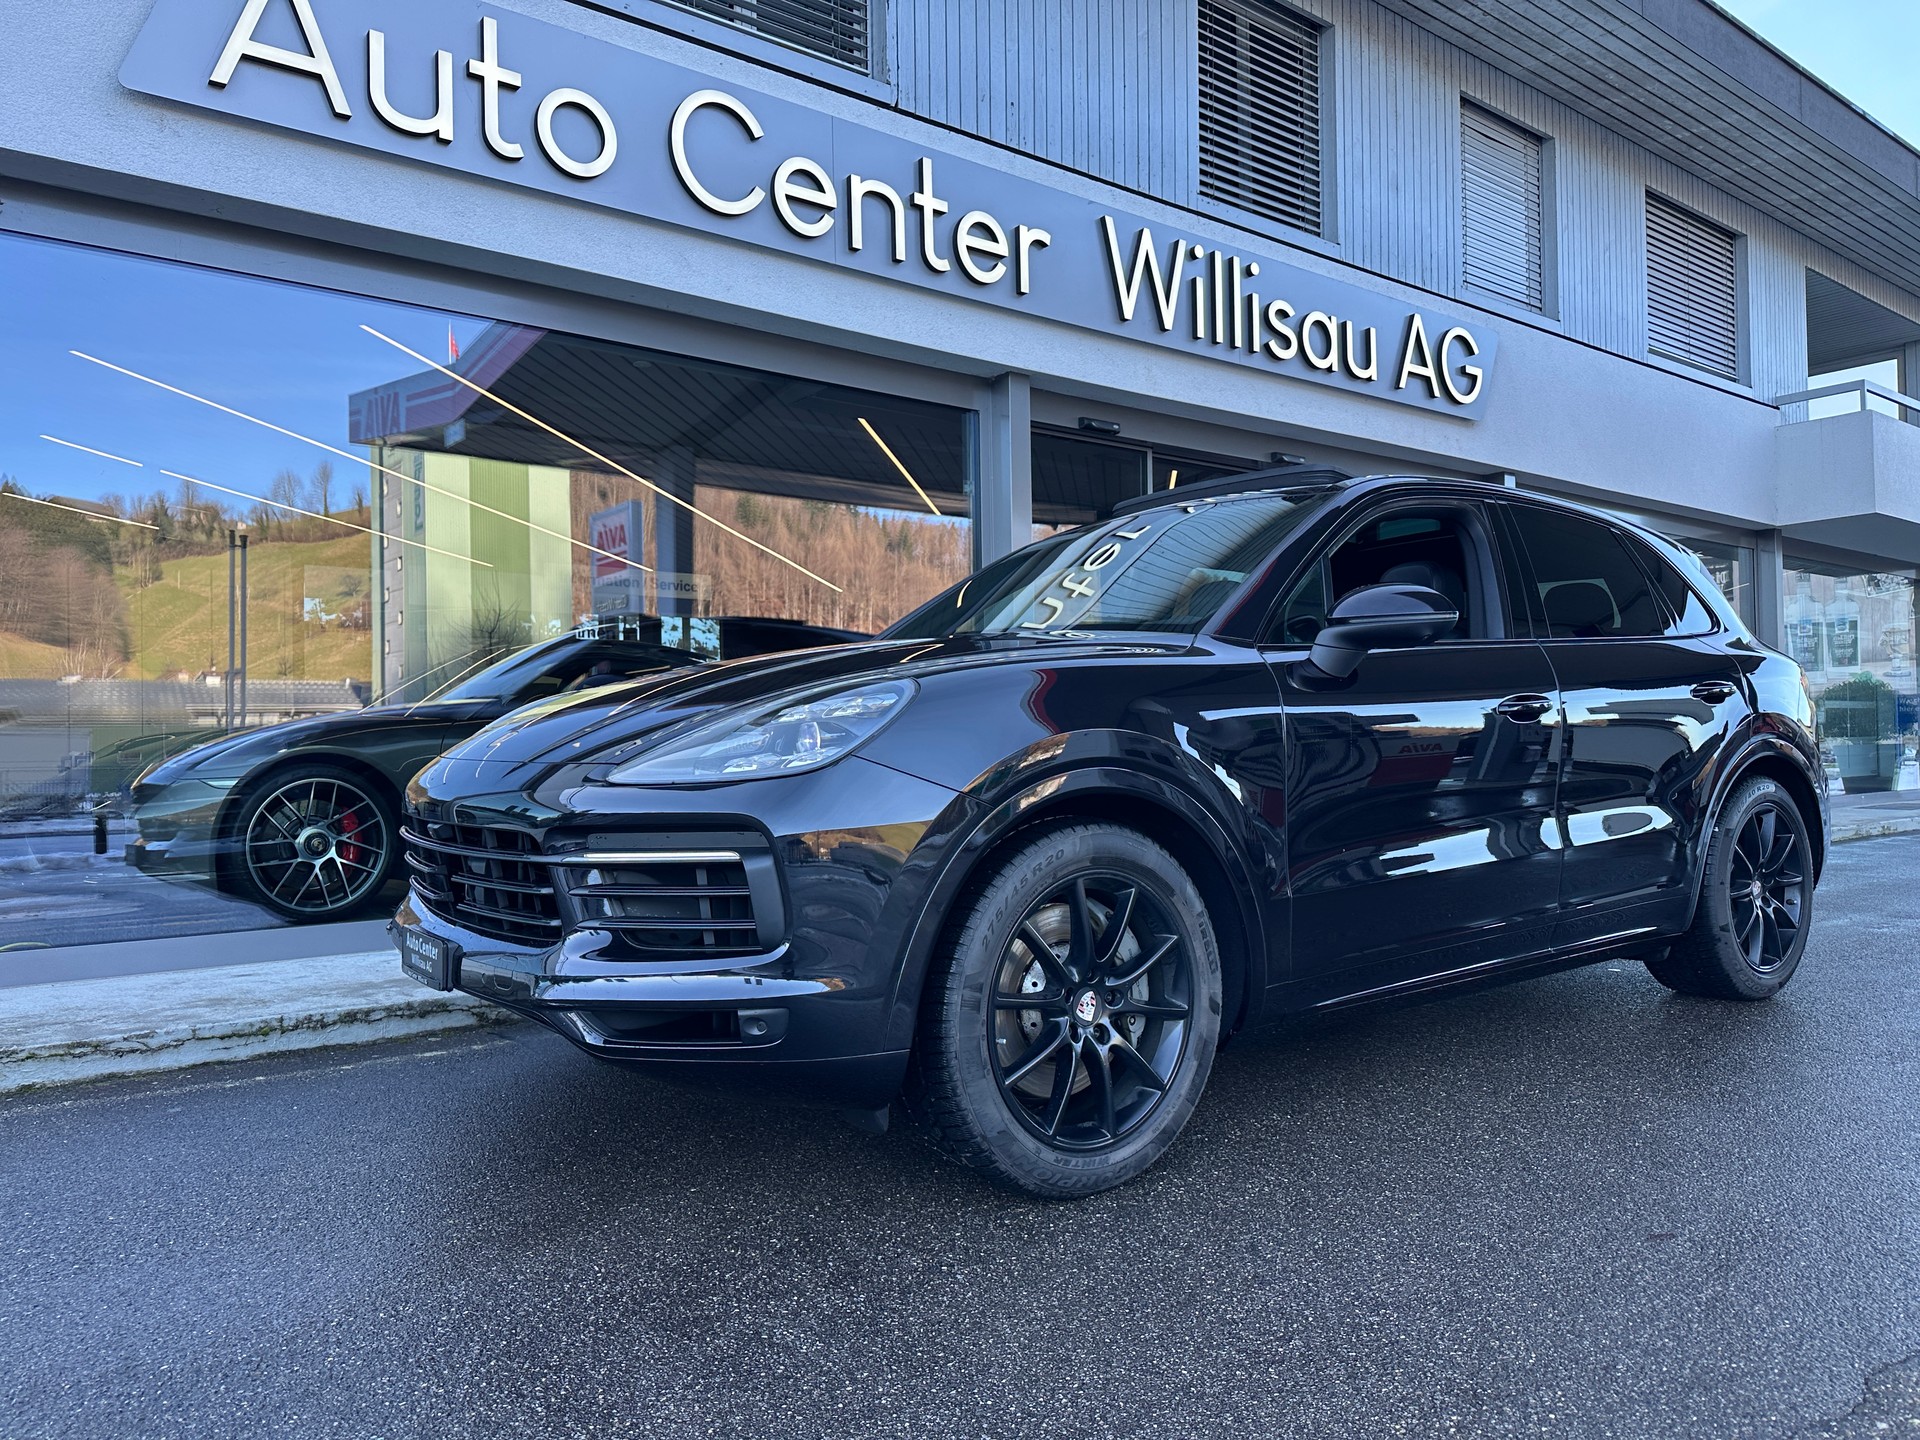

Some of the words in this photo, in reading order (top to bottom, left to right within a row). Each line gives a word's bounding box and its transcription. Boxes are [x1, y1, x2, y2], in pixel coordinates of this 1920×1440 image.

[207, 0, 617, 178] Auto
[667, 88, 1052, 296] Center
[1100, 214, 1379, 383] Willisau
[1395, 313, 1485, 405] AG
[1031, 848, 1065, 877] R20
[406, 931, 418, 952] Auto
[418, 937, 438, 960] Center
